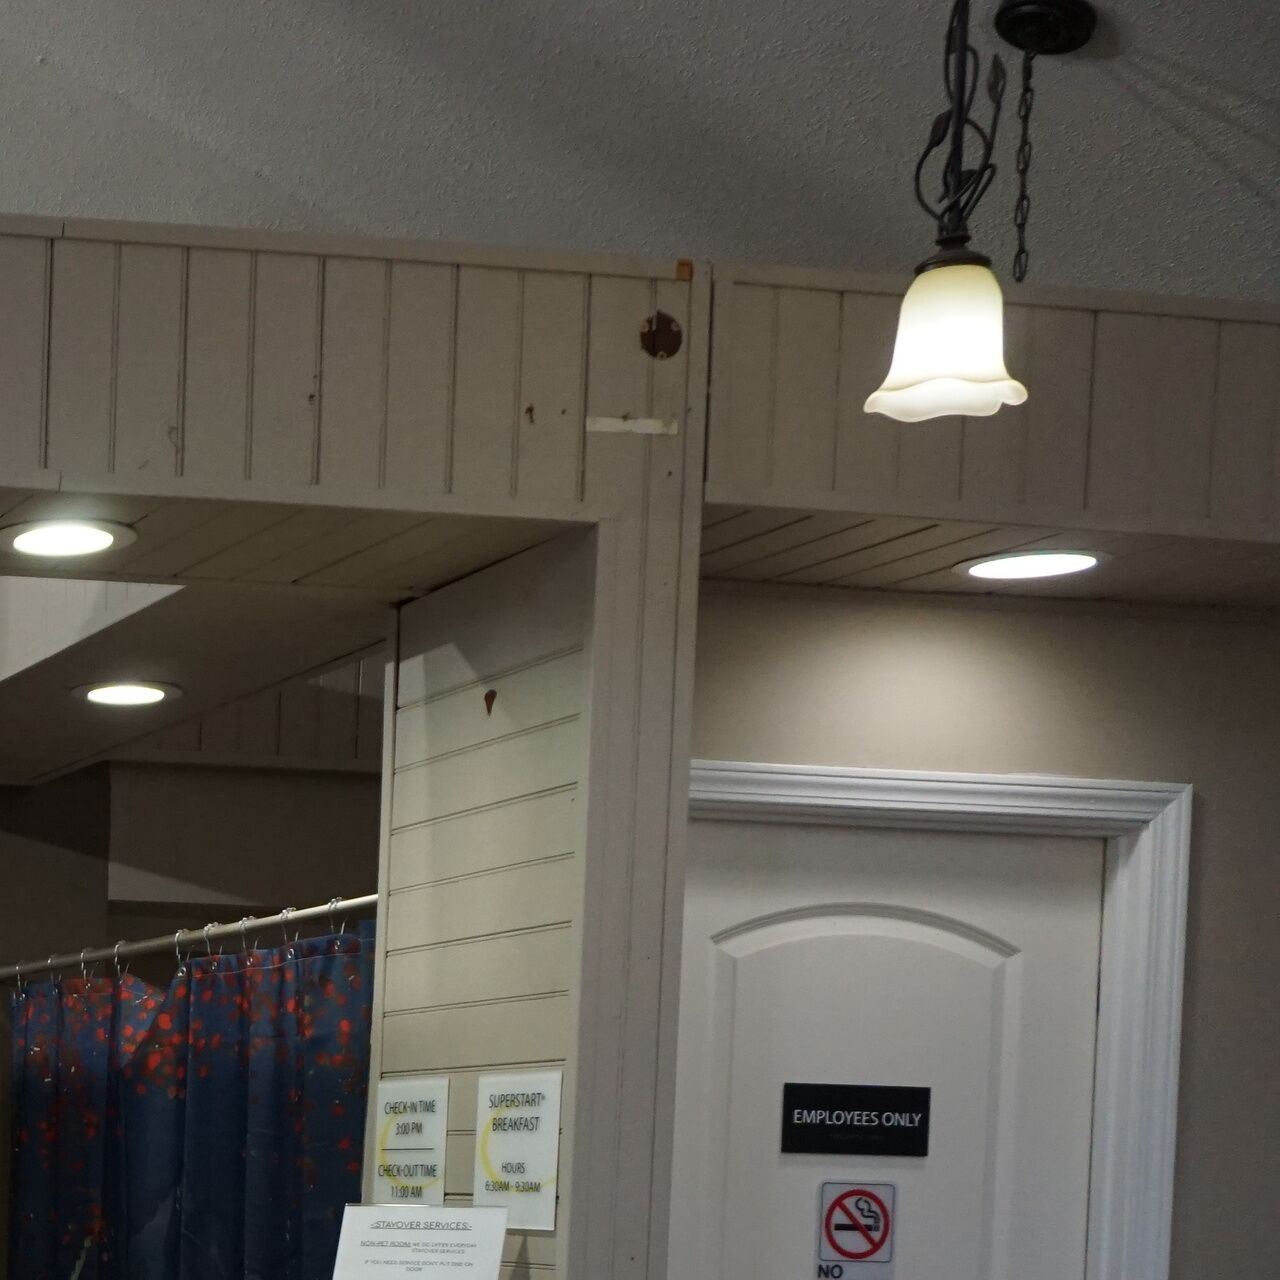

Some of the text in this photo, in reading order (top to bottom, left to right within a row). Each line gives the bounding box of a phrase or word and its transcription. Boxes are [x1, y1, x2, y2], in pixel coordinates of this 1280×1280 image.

[384, 1100, 435, 1114] CHECK-IN TIME
[793, 1109, 922, 1126] EMPLOYEES ONLY
[396, 1122, 423, 1135] 3:00 PM
[492, 1117, 539, 1132] BREAKFAST
[378, 1164, 437, 1177] CHECK-OUT TIME
[502, 1163, 525, 1174] HOURS
[391, 1186, 422, 1198] 11:00 AM
[485, 1181, 510, 1192] 6:30AM
[515, 1182, 540, 1193] 9:30AM
[817, 1264, 843, 1279] NO
